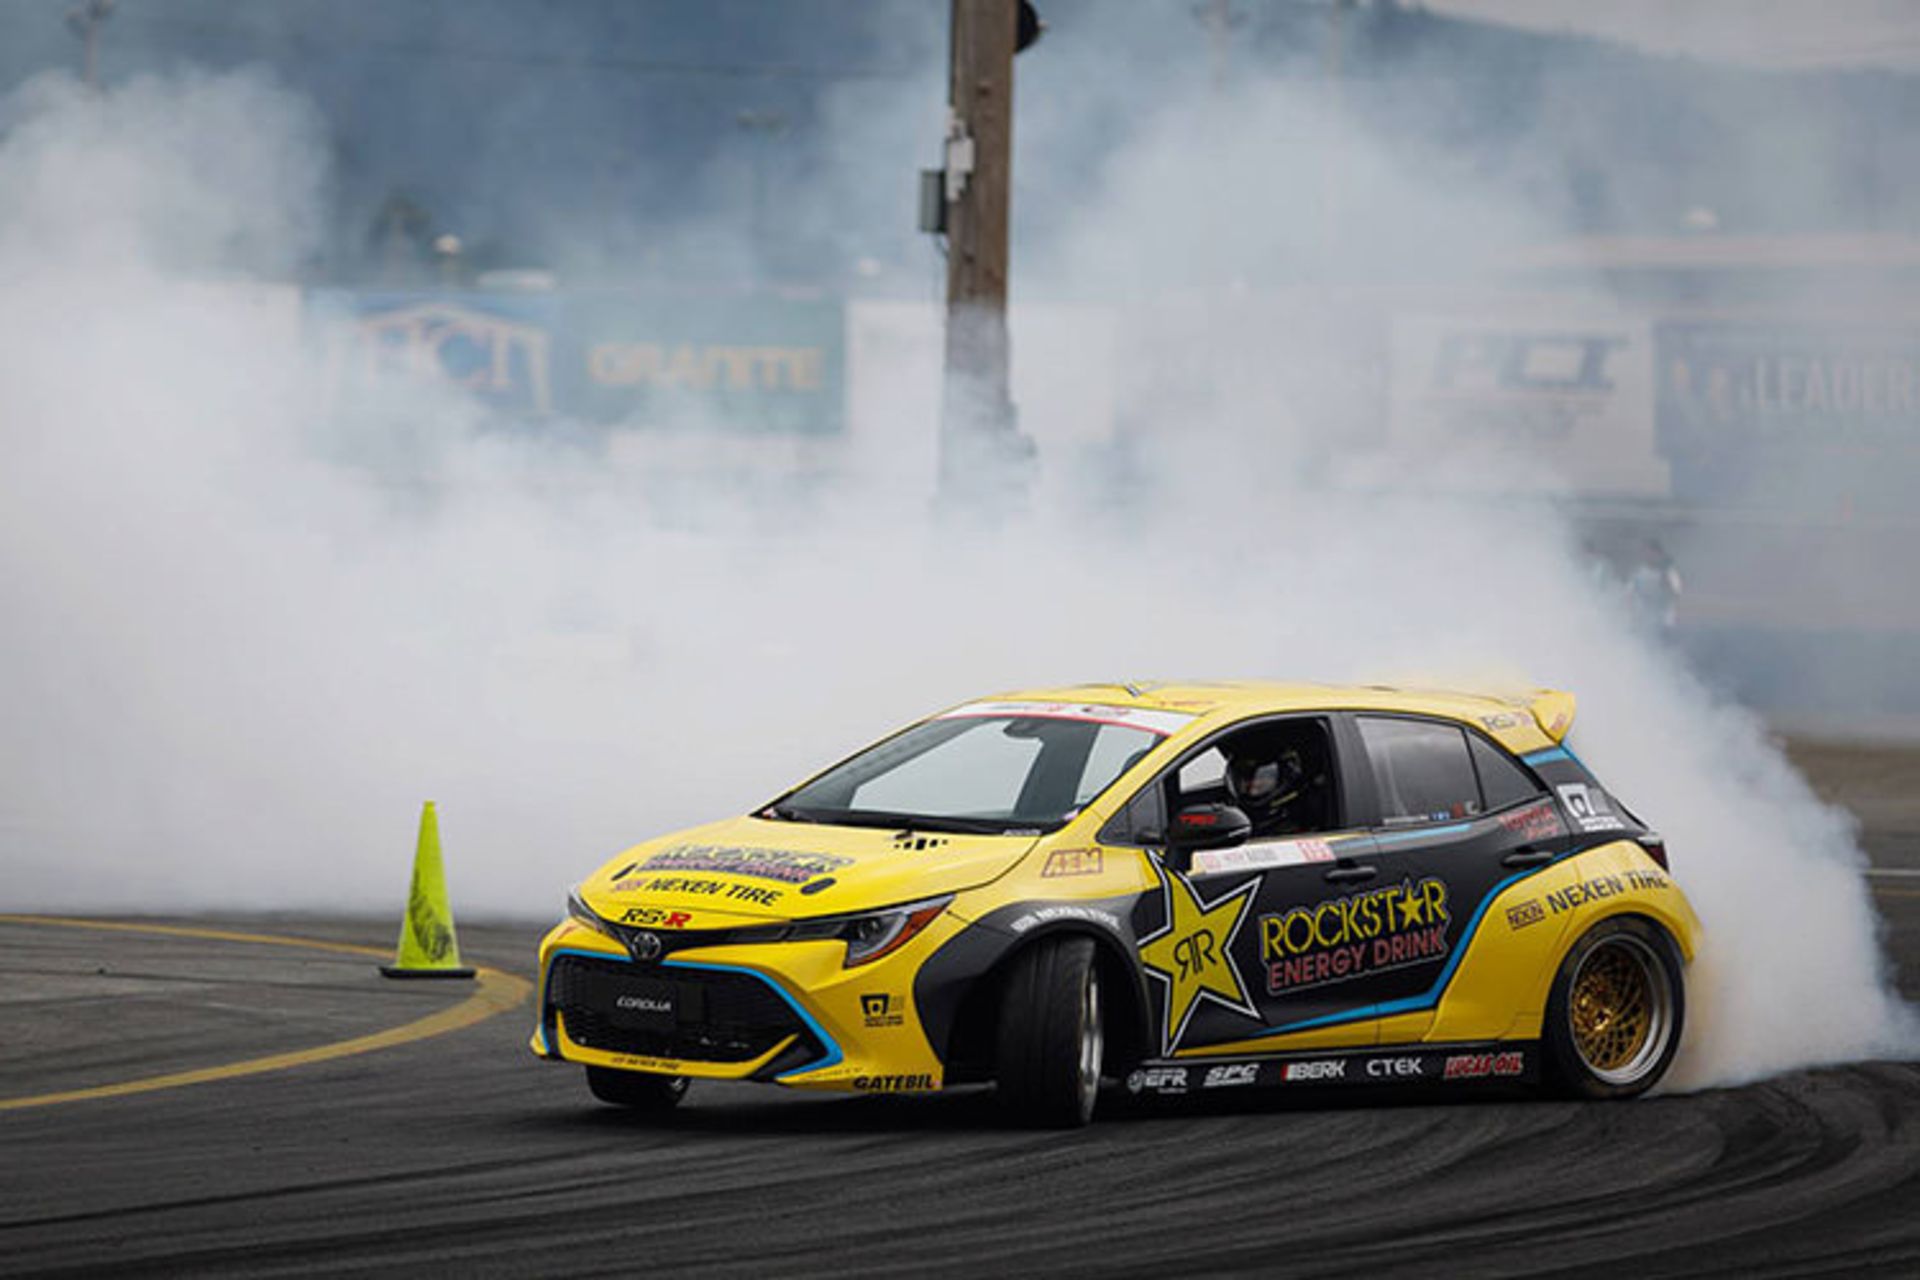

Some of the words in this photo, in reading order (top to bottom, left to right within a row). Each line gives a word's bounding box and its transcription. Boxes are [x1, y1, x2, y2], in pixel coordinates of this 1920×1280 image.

[646, 878, 726, 895] NEXEN
[726, 884, 783, 907] TIRE
[1545, 875, 1625, 914] NEXEN
[1268, 943, 1368, 989] ENERGY
[1373, 924, 1445, 966] DRINK
[1366, 1057, 1422, 1077] CTEK
